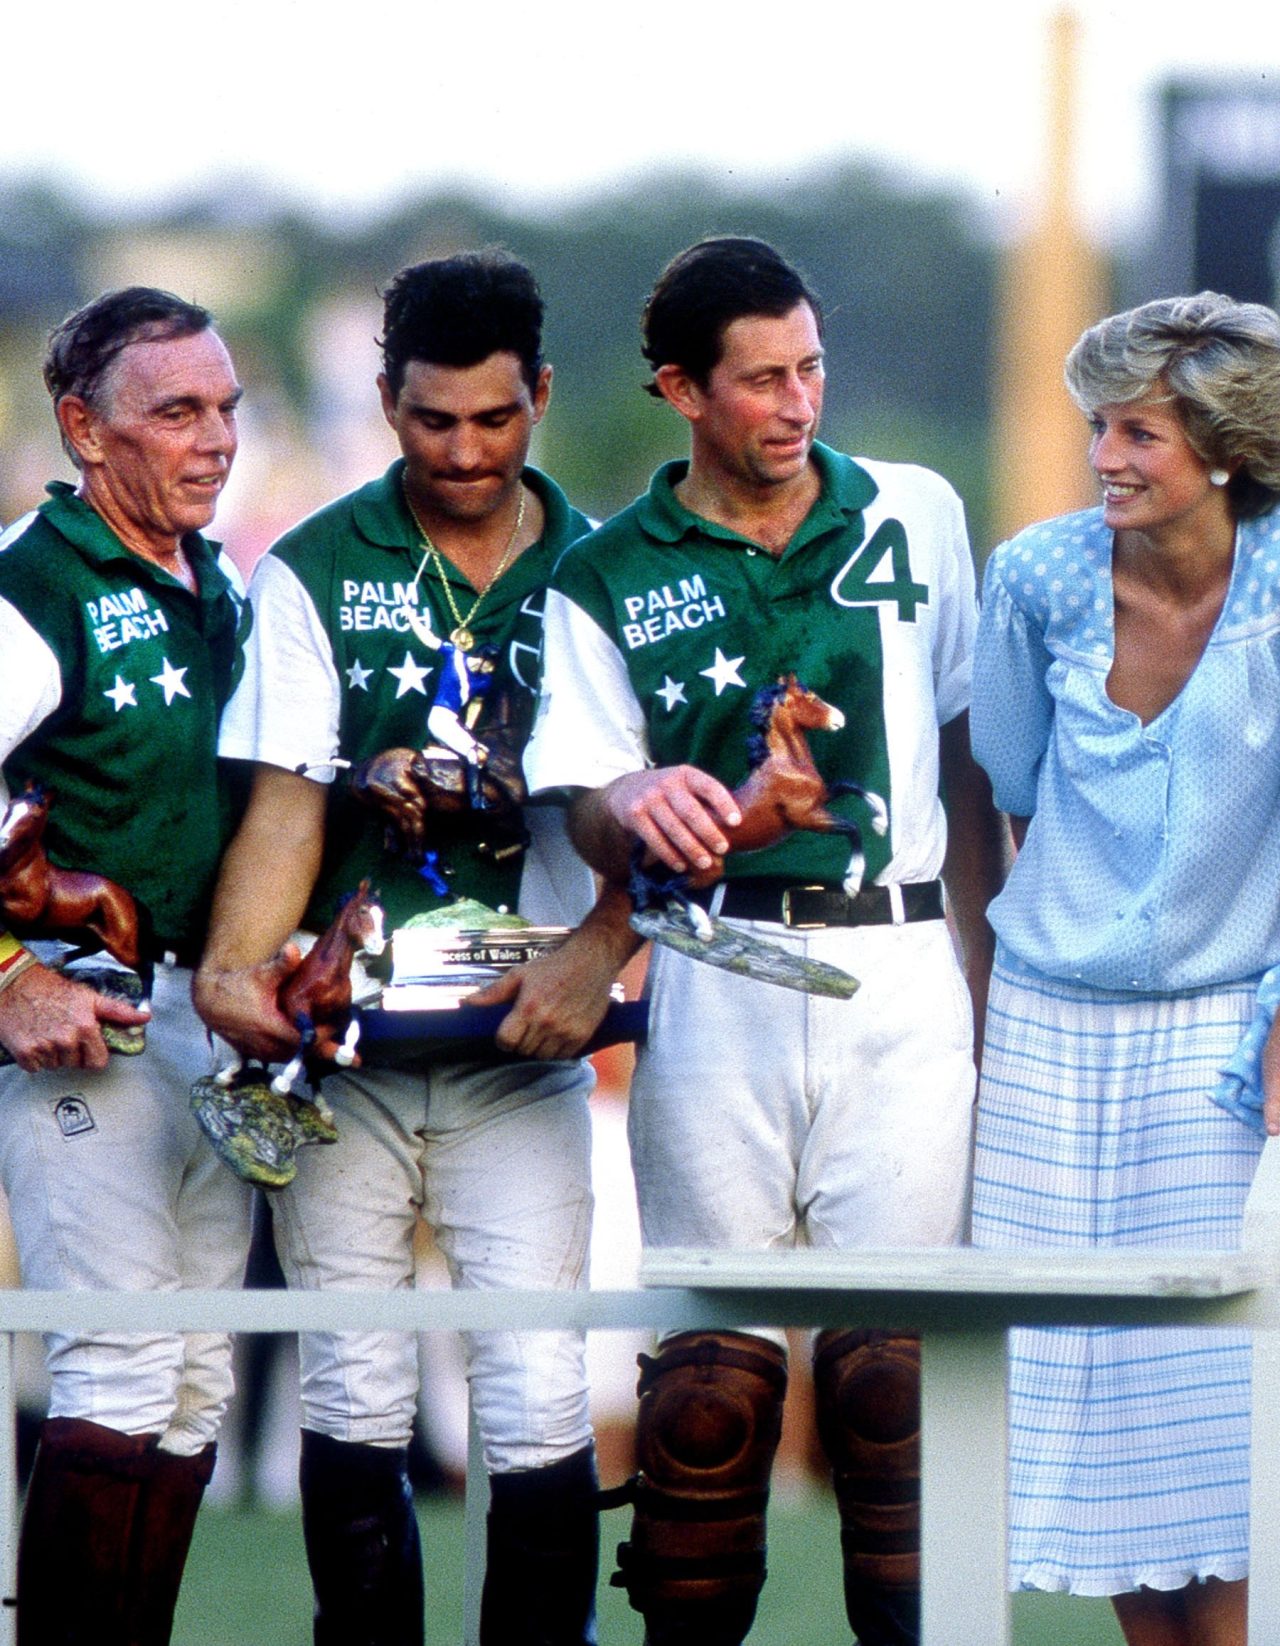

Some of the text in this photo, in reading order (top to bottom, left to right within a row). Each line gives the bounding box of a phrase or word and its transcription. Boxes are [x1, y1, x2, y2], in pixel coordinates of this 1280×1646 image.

[836, 517, 929, 624] 4
[86, 587, 148, 626] PALM
[343, 579, 419, 605] PALM
[624, 573, 708, 621] PALM
[93, 609, 169, 653] BEACH
[340, 606, 432, 632] BEACH
[622, 595, 725, 650] BEACH
[473, 949, 486, 961] of
[488, 949, 521, 961] Wales
